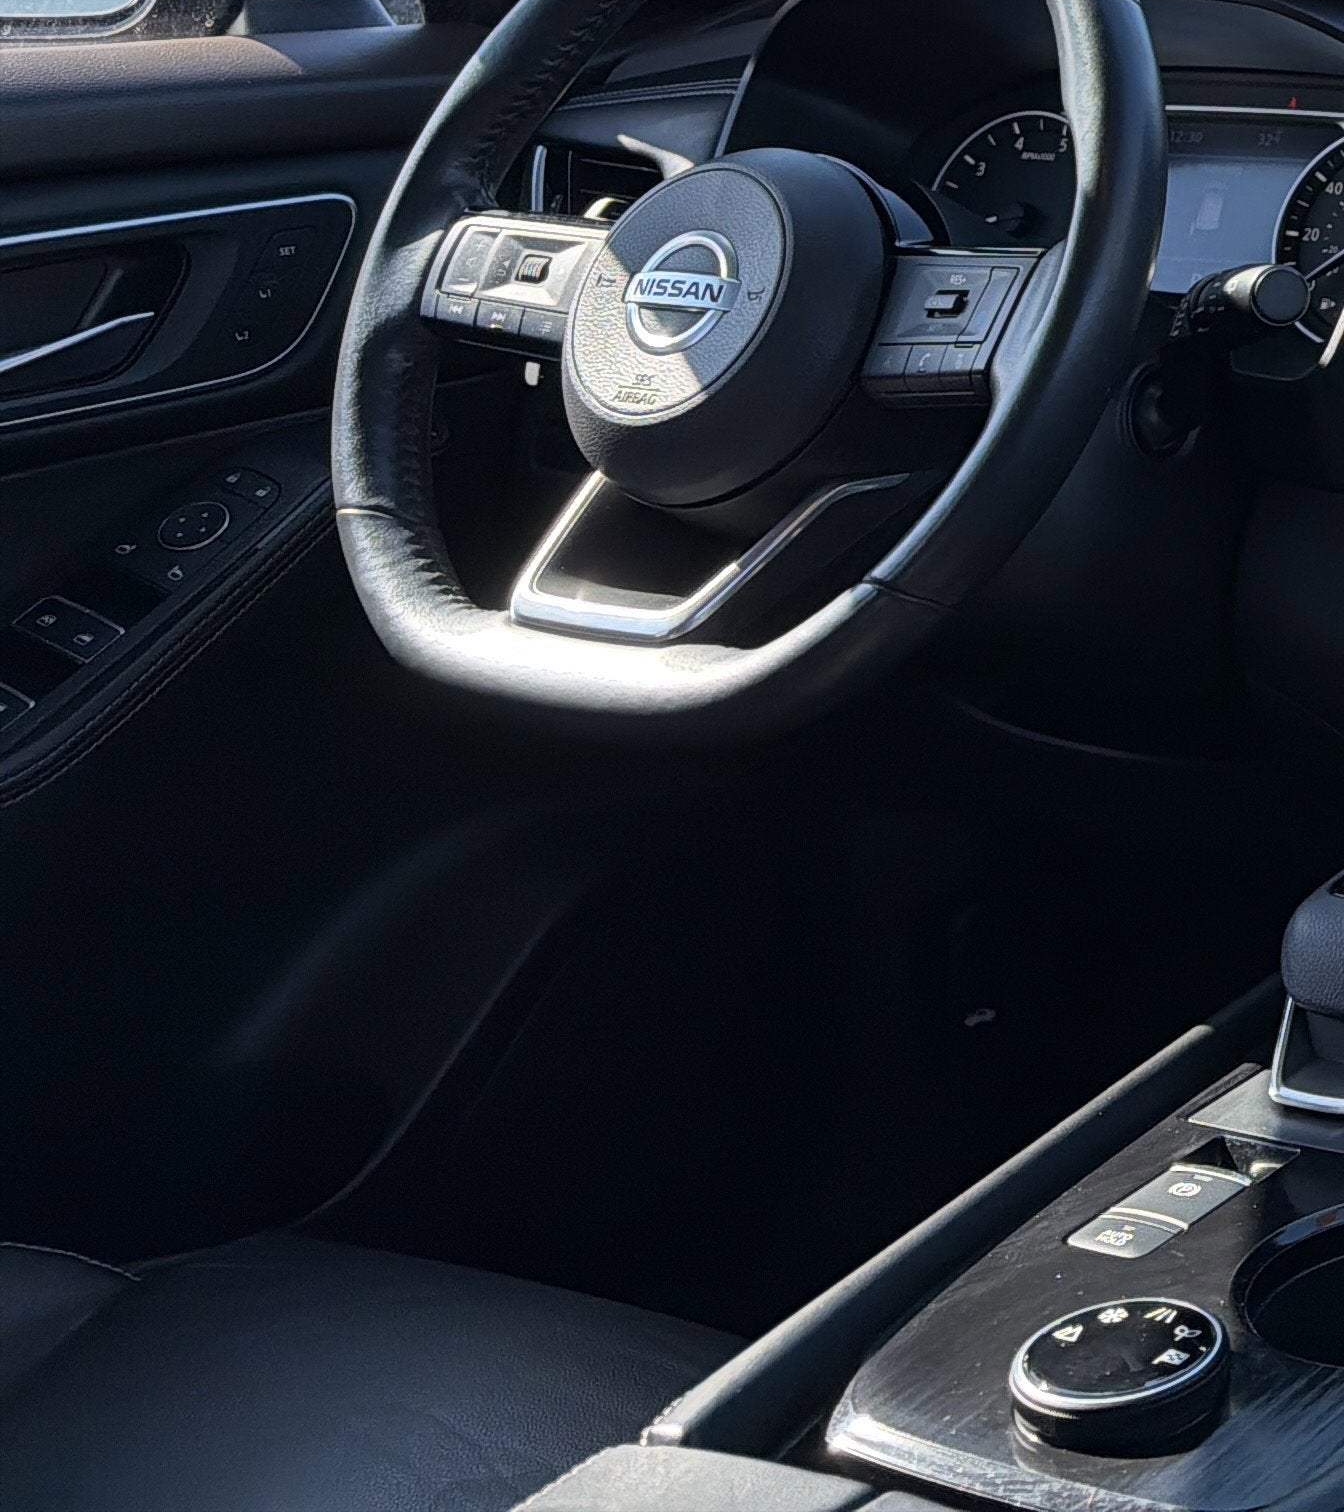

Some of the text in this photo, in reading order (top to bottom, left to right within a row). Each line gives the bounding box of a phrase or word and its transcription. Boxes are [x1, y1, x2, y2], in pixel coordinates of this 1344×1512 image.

[1014, 137, 1024, 151] 4
[1059, 139, 1068, 152] 5
[975, 161, 986, 176] 3
[1325, 182, 1343, 195] 40
[1302, 228, 1320, 242] 20
[280, 246, 296, 256] SET
[633, 278, 724, 303] NISSAN
[612, 390, 657, 405] AIRBAG
[1095, 1236, 1127, 1247] HOLD
[1102, 1229, 1134, 1241] AUTO
